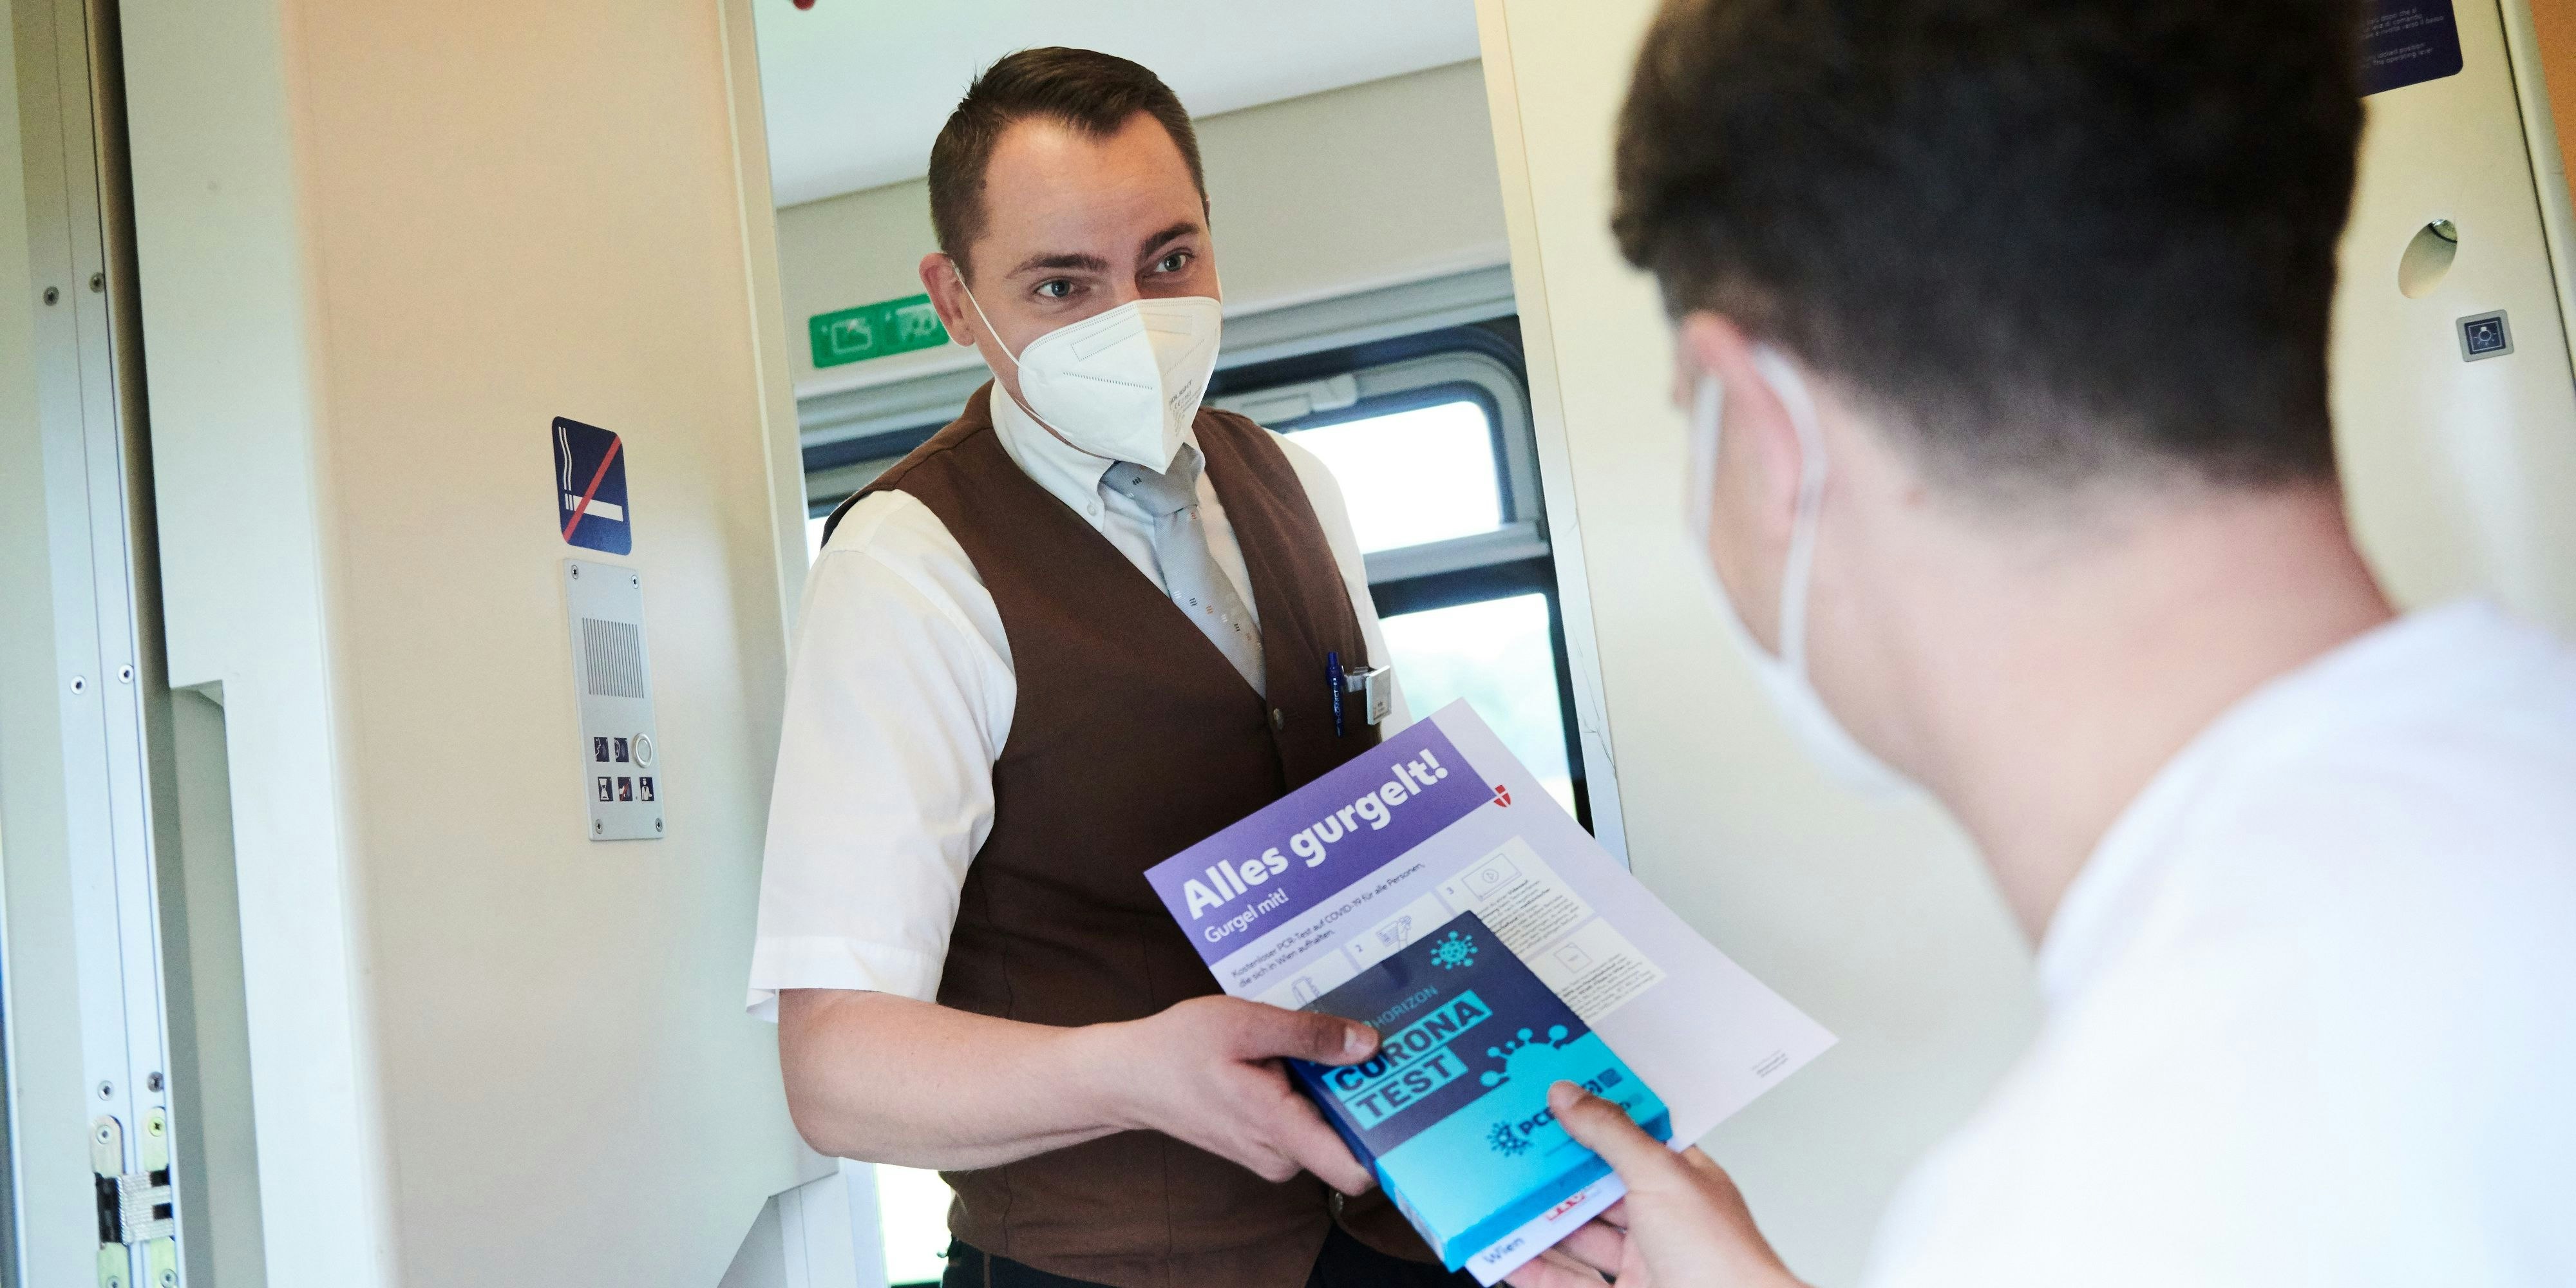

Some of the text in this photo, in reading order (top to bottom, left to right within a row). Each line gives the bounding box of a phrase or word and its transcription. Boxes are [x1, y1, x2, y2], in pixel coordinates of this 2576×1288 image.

[1182, 748, 1449, 920] Alles gurgelt!
[1204, 887, 1289, 943] Gurgel mit!
[1231, 862, 1426, 978] Kostenloser PCR-Test auf COVID-19 für alle Personen,
[1446, 886, 1455, 895] 3
[1239, 977, 1253, 989] die
[1252, 967, 1267, 980] sich
[1276, 950, 1296, 965] Wien
[1297, 929, 1336, 953] aufhalten.
[1355, 943, 1363, 952] 2
[1334, 1000, 1484, 1091] CORONA
[1354, 1054, 1451, 1117] TEST
[1482, 1237, 1525, 1264] Wien
